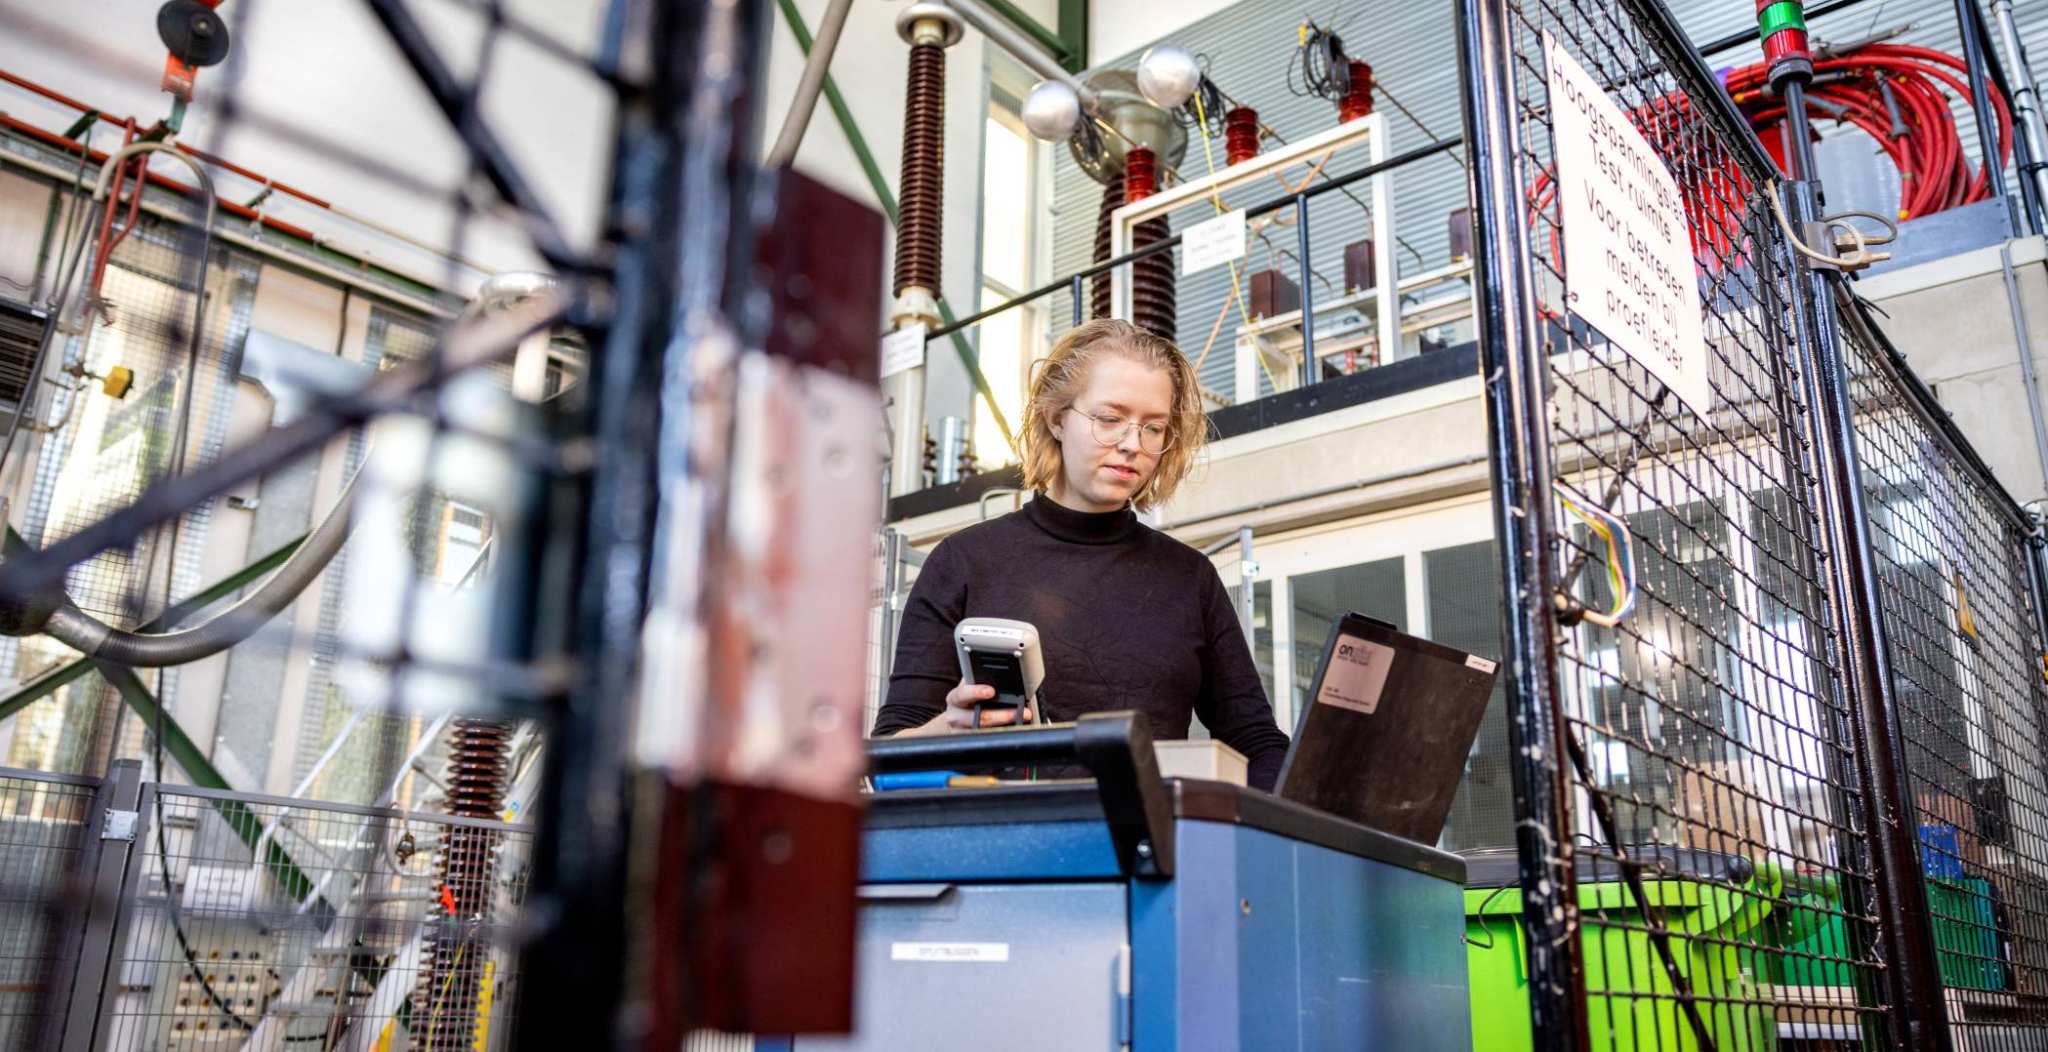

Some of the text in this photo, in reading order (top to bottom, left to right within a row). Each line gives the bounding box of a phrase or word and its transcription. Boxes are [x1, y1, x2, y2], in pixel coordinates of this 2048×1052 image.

[1589, 132, 1671, 245] Test ruimte
[1584, 178, 1686, 306] Voor betreden
[1606, 249, 1679, 340] melden bij
[1606, 287, 1683, 374] proefleider
